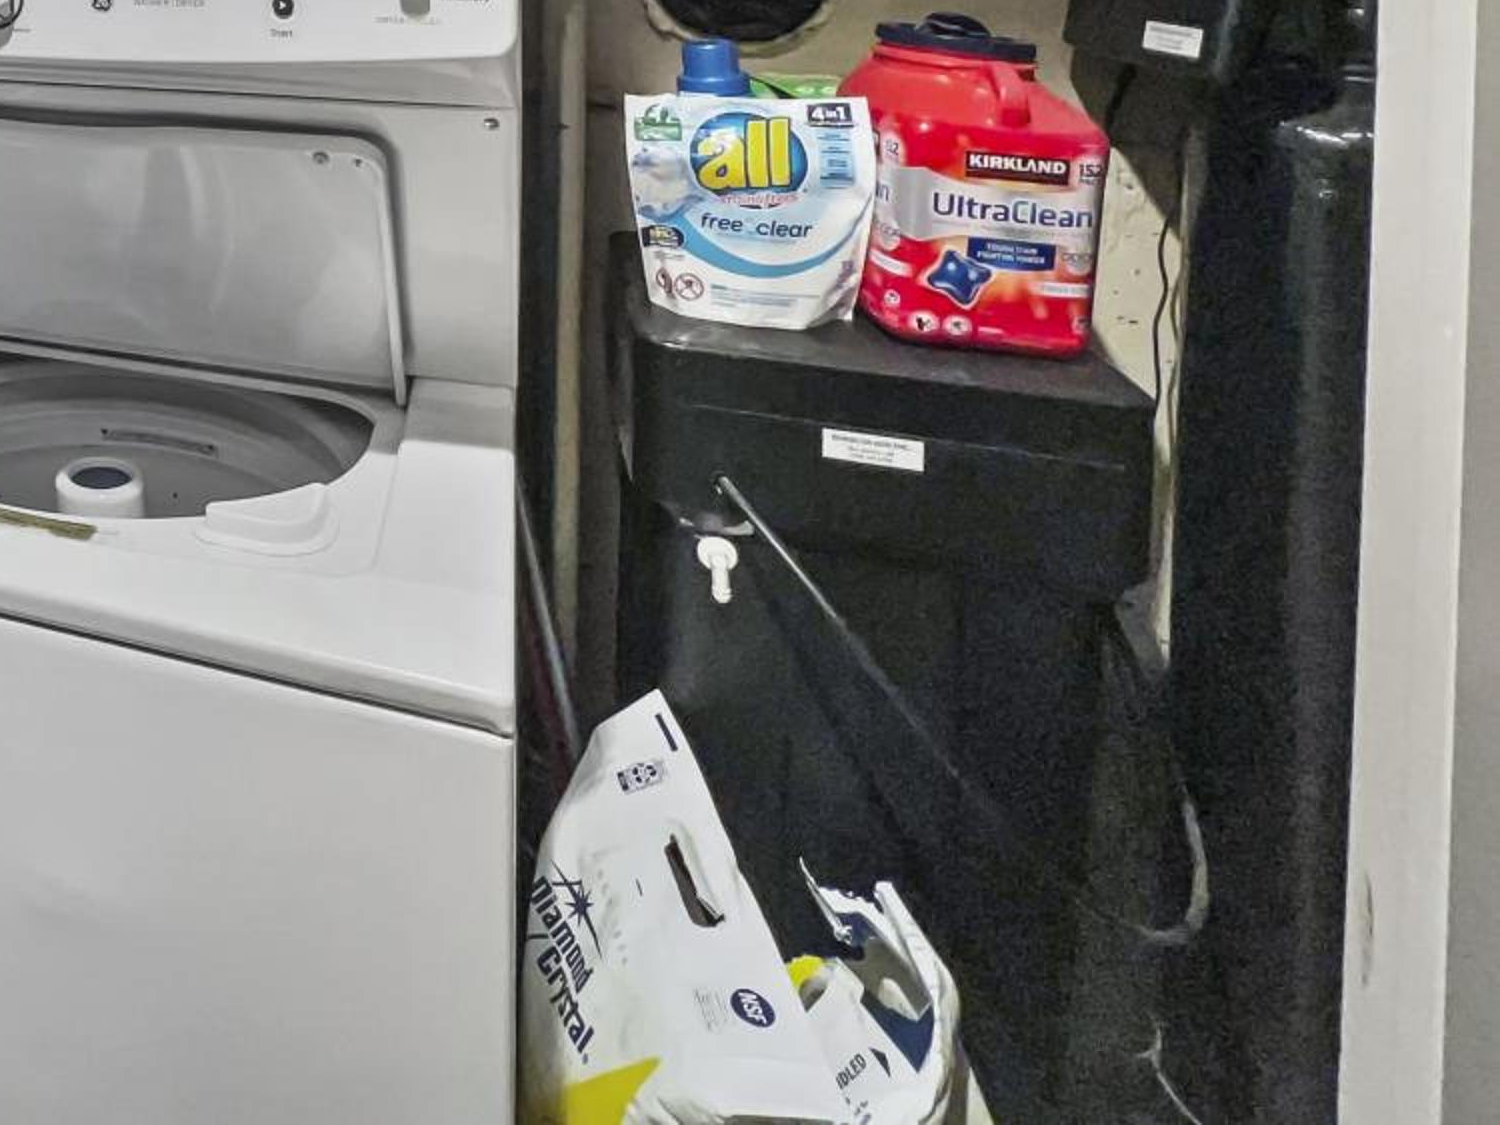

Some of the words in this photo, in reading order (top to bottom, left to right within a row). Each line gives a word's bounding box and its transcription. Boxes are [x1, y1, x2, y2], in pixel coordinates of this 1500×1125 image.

[698, 116, 792, 191] all
[968, 153, 1068, 176] KIRKLAND
[701, 212, 743, 233] free
[756, 220, 813, 238] clear
[932, 192, 1093, 229] UltraClean
[531, 875, 594, 993] Diamond
[537, 945, 595, 1053] Crystal
[737, 992, 769, 1025] NSF
